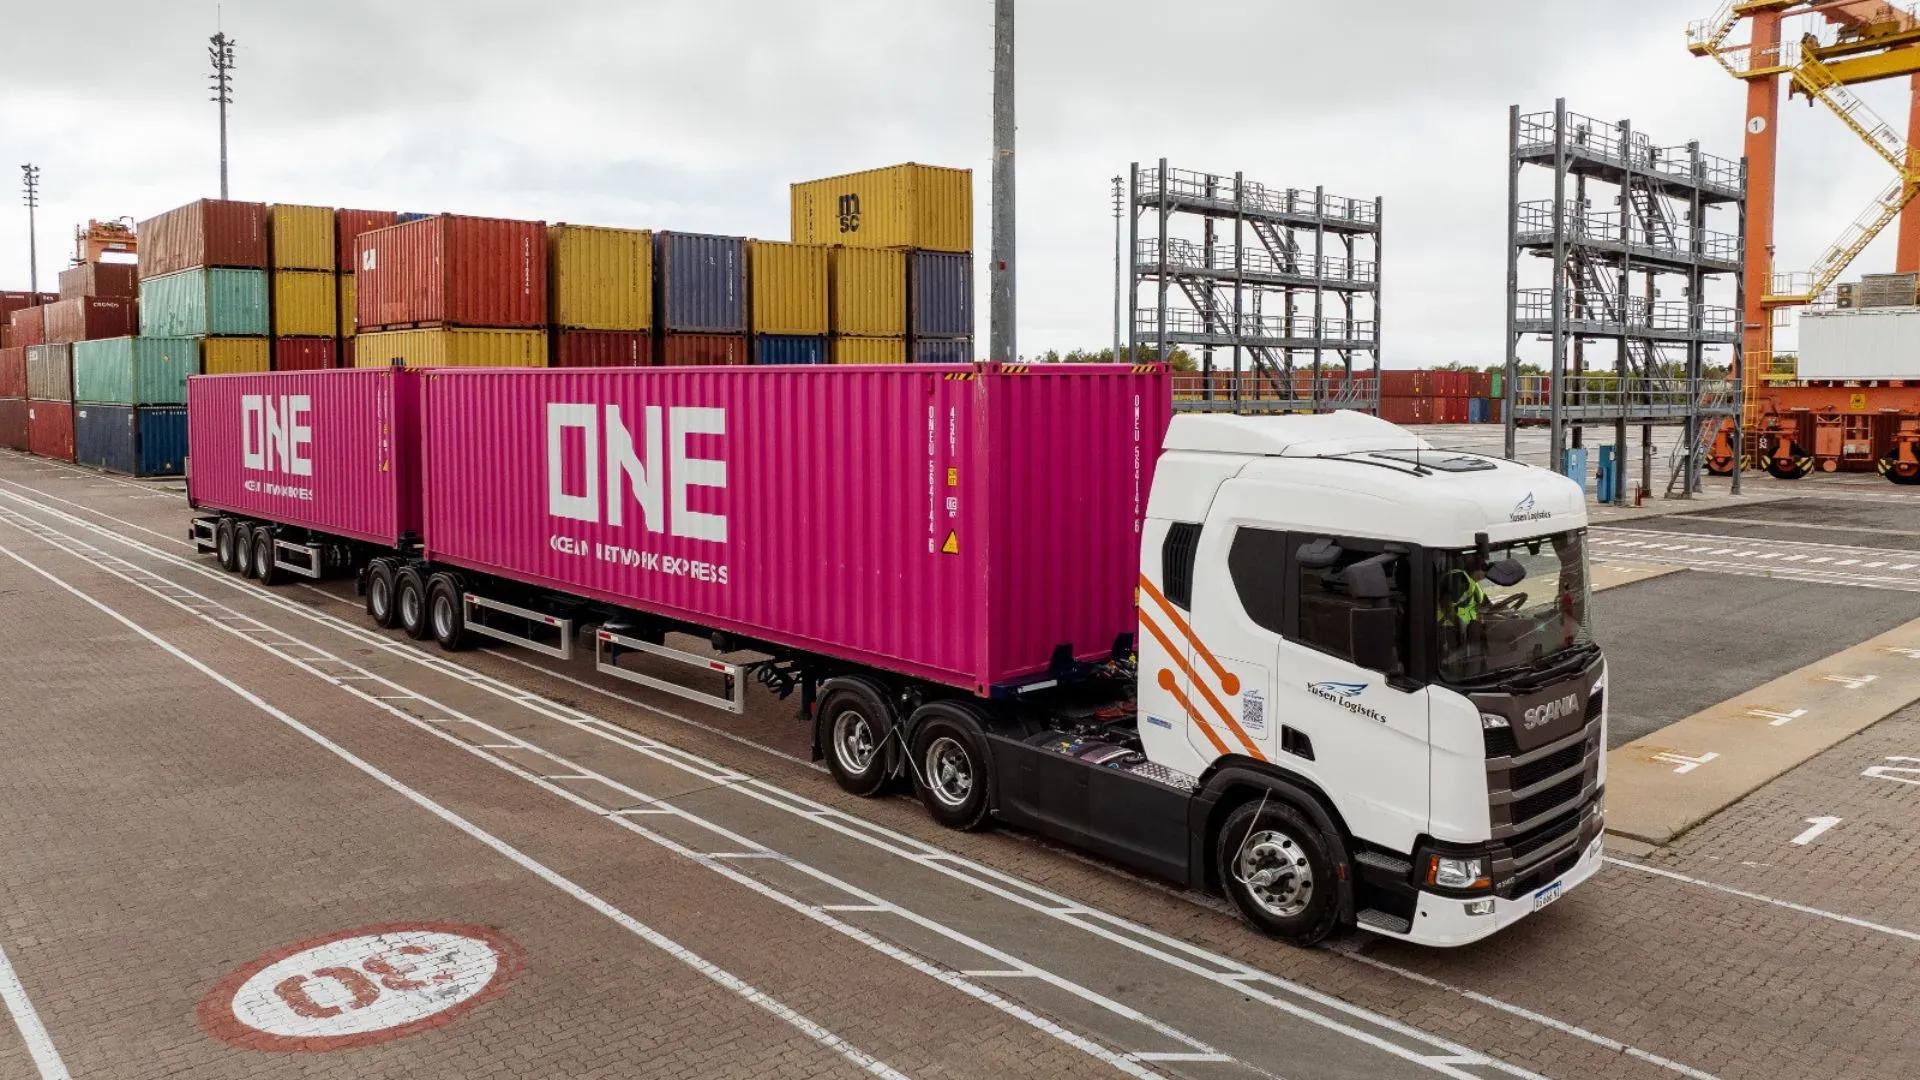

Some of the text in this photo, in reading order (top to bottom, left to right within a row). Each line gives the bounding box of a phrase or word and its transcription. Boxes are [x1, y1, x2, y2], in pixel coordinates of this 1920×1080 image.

[1752, 120, 1758, 131] 1
[242, 394, 312, 476] ONE
[547, 403, 727, 543] ONE
[1307, 682, 1386, 723] Yusen Logistics
[1524, 692, 1580, 730] SCANIA
